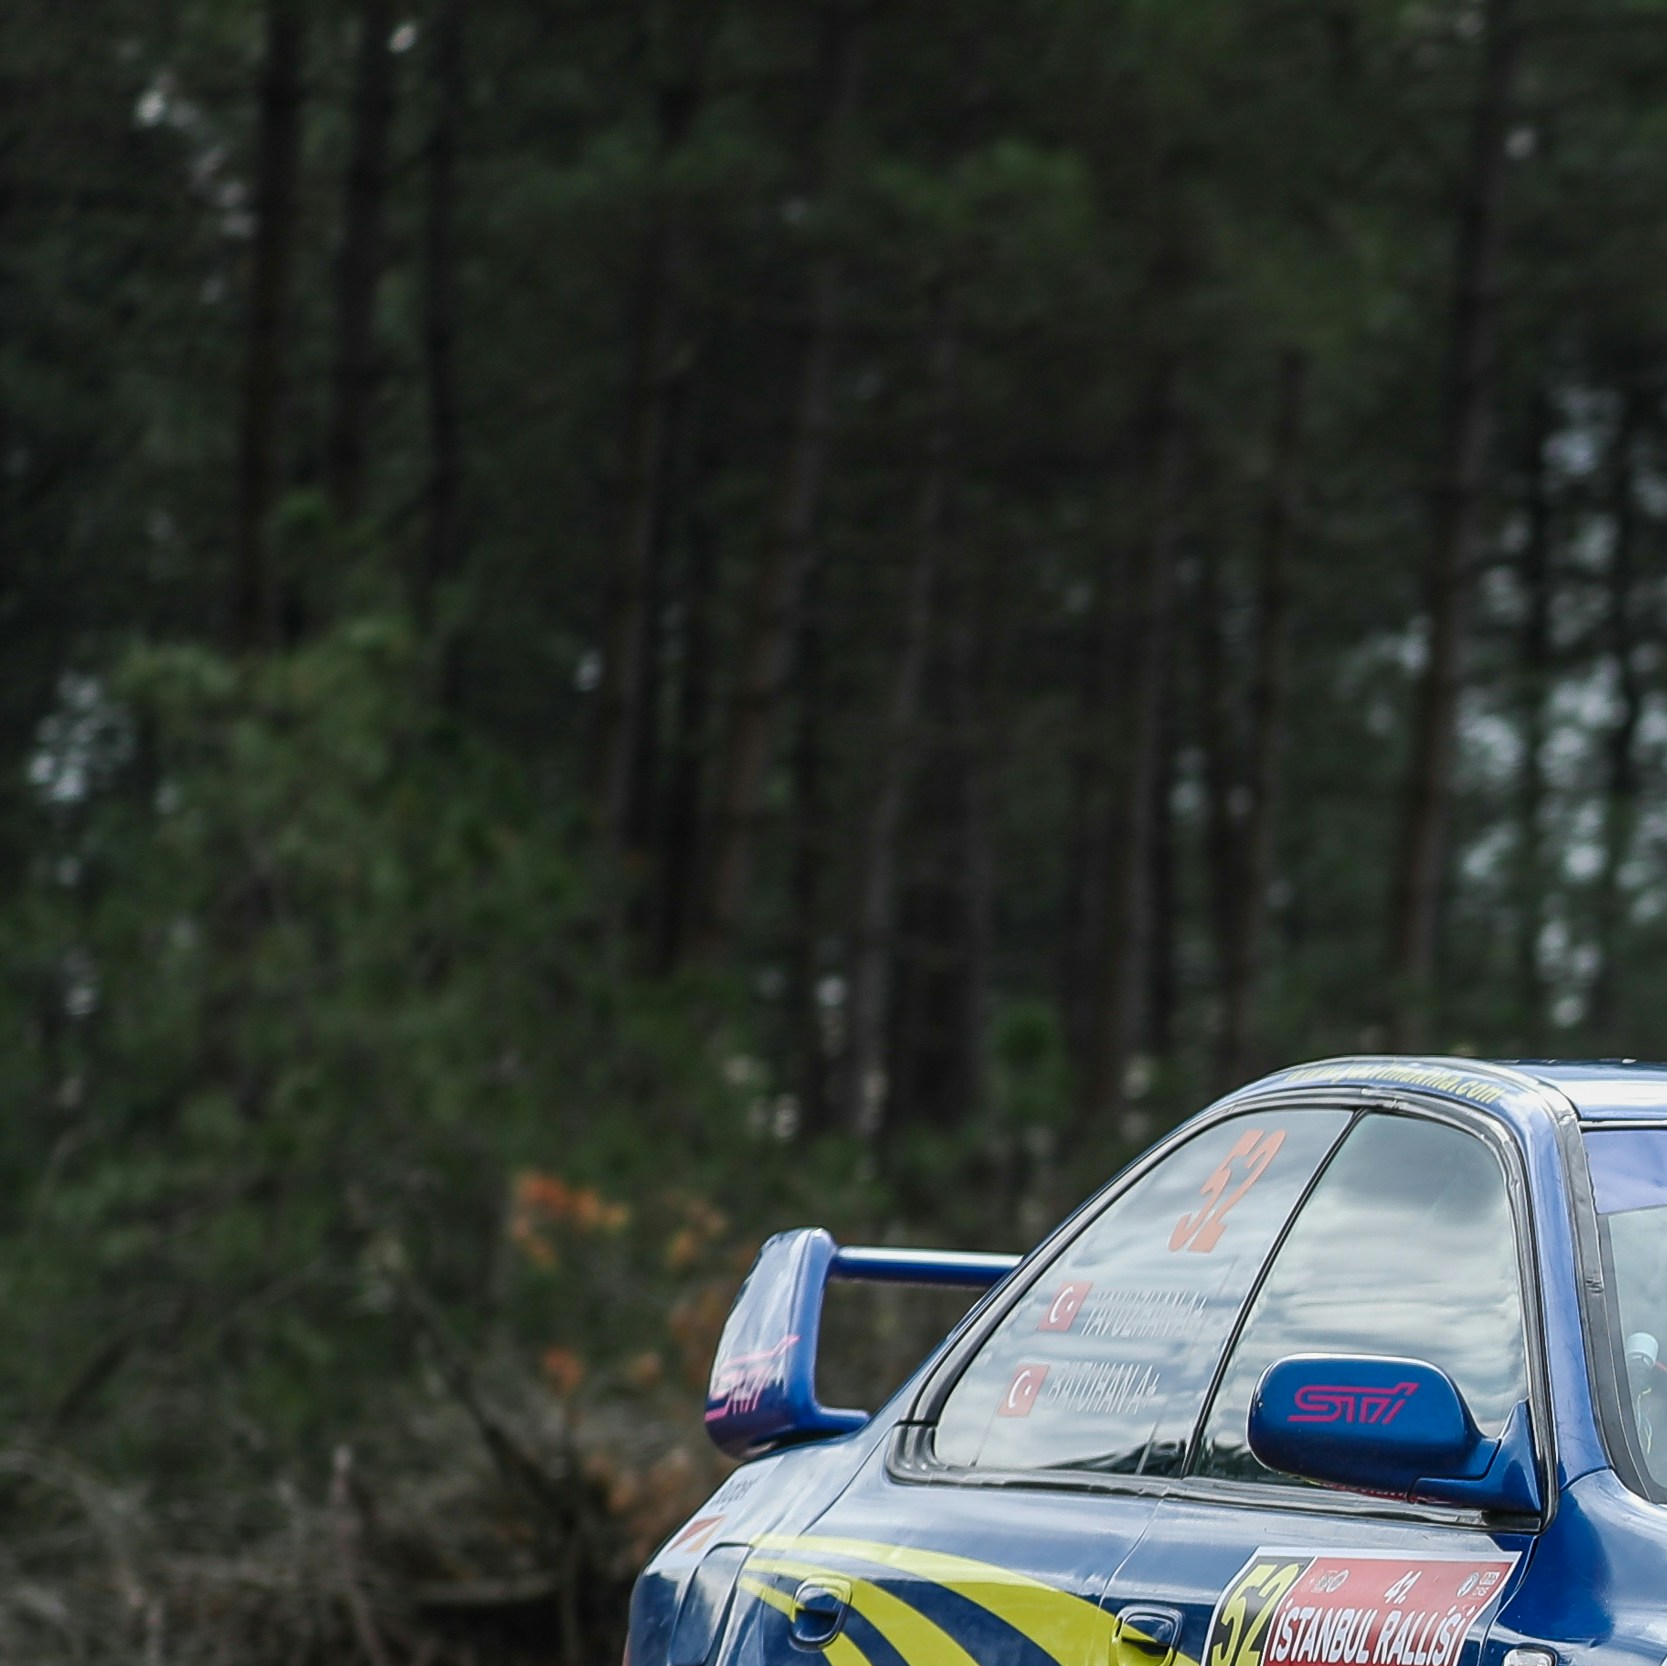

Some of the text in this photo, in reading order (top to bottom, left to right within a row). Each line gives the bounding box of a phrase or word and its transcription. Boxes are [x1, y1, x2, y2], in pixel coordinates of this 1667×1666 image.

[1168, 1130, 1286, 1253] 52
[1269, 1598, 1476, 1666] İSTANBUL RALLİSİ
